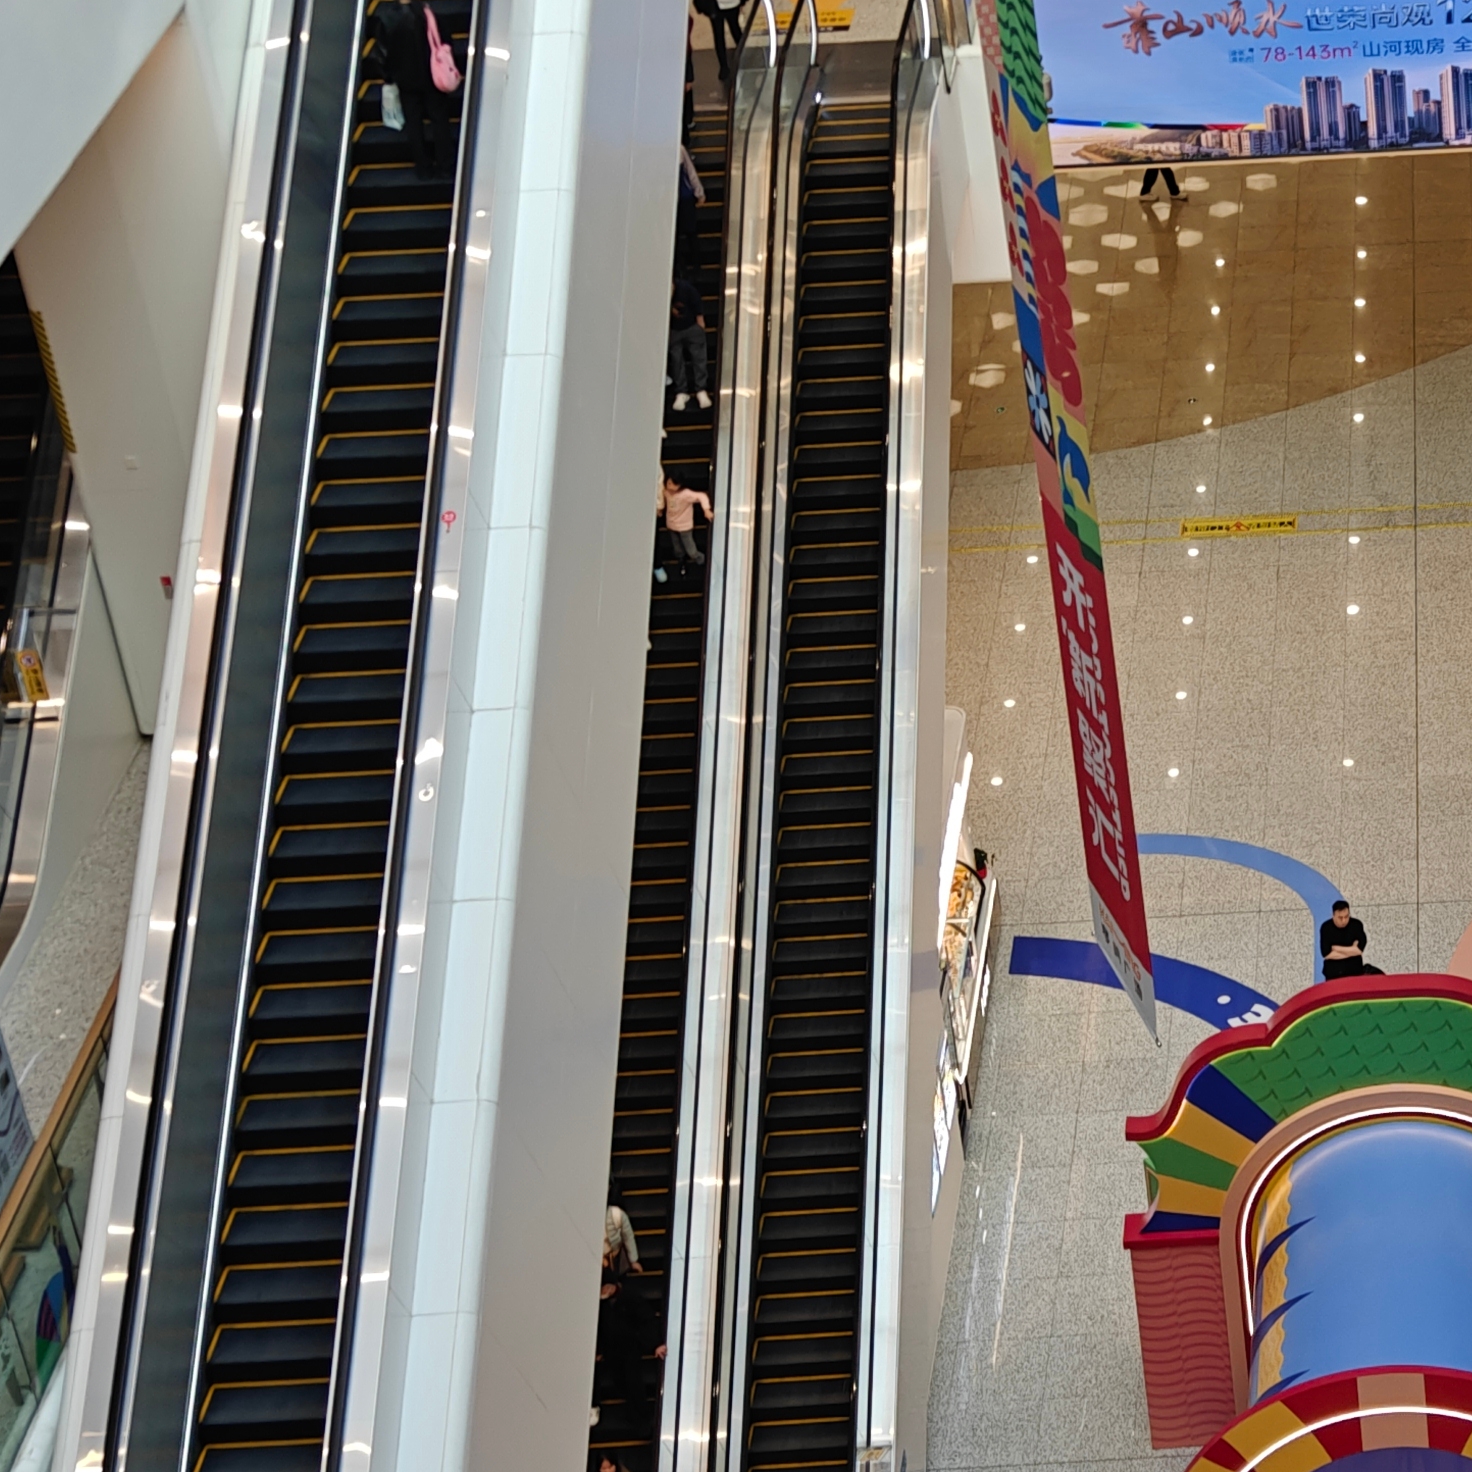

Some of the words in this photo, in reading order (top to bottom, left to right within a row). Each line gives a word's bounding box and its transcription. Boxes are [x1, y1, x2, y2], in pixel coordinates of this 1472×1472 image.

[1306, 2, 1433, 33] 世荣尚观
[1362, 36, 1444, 59] 山河现房
